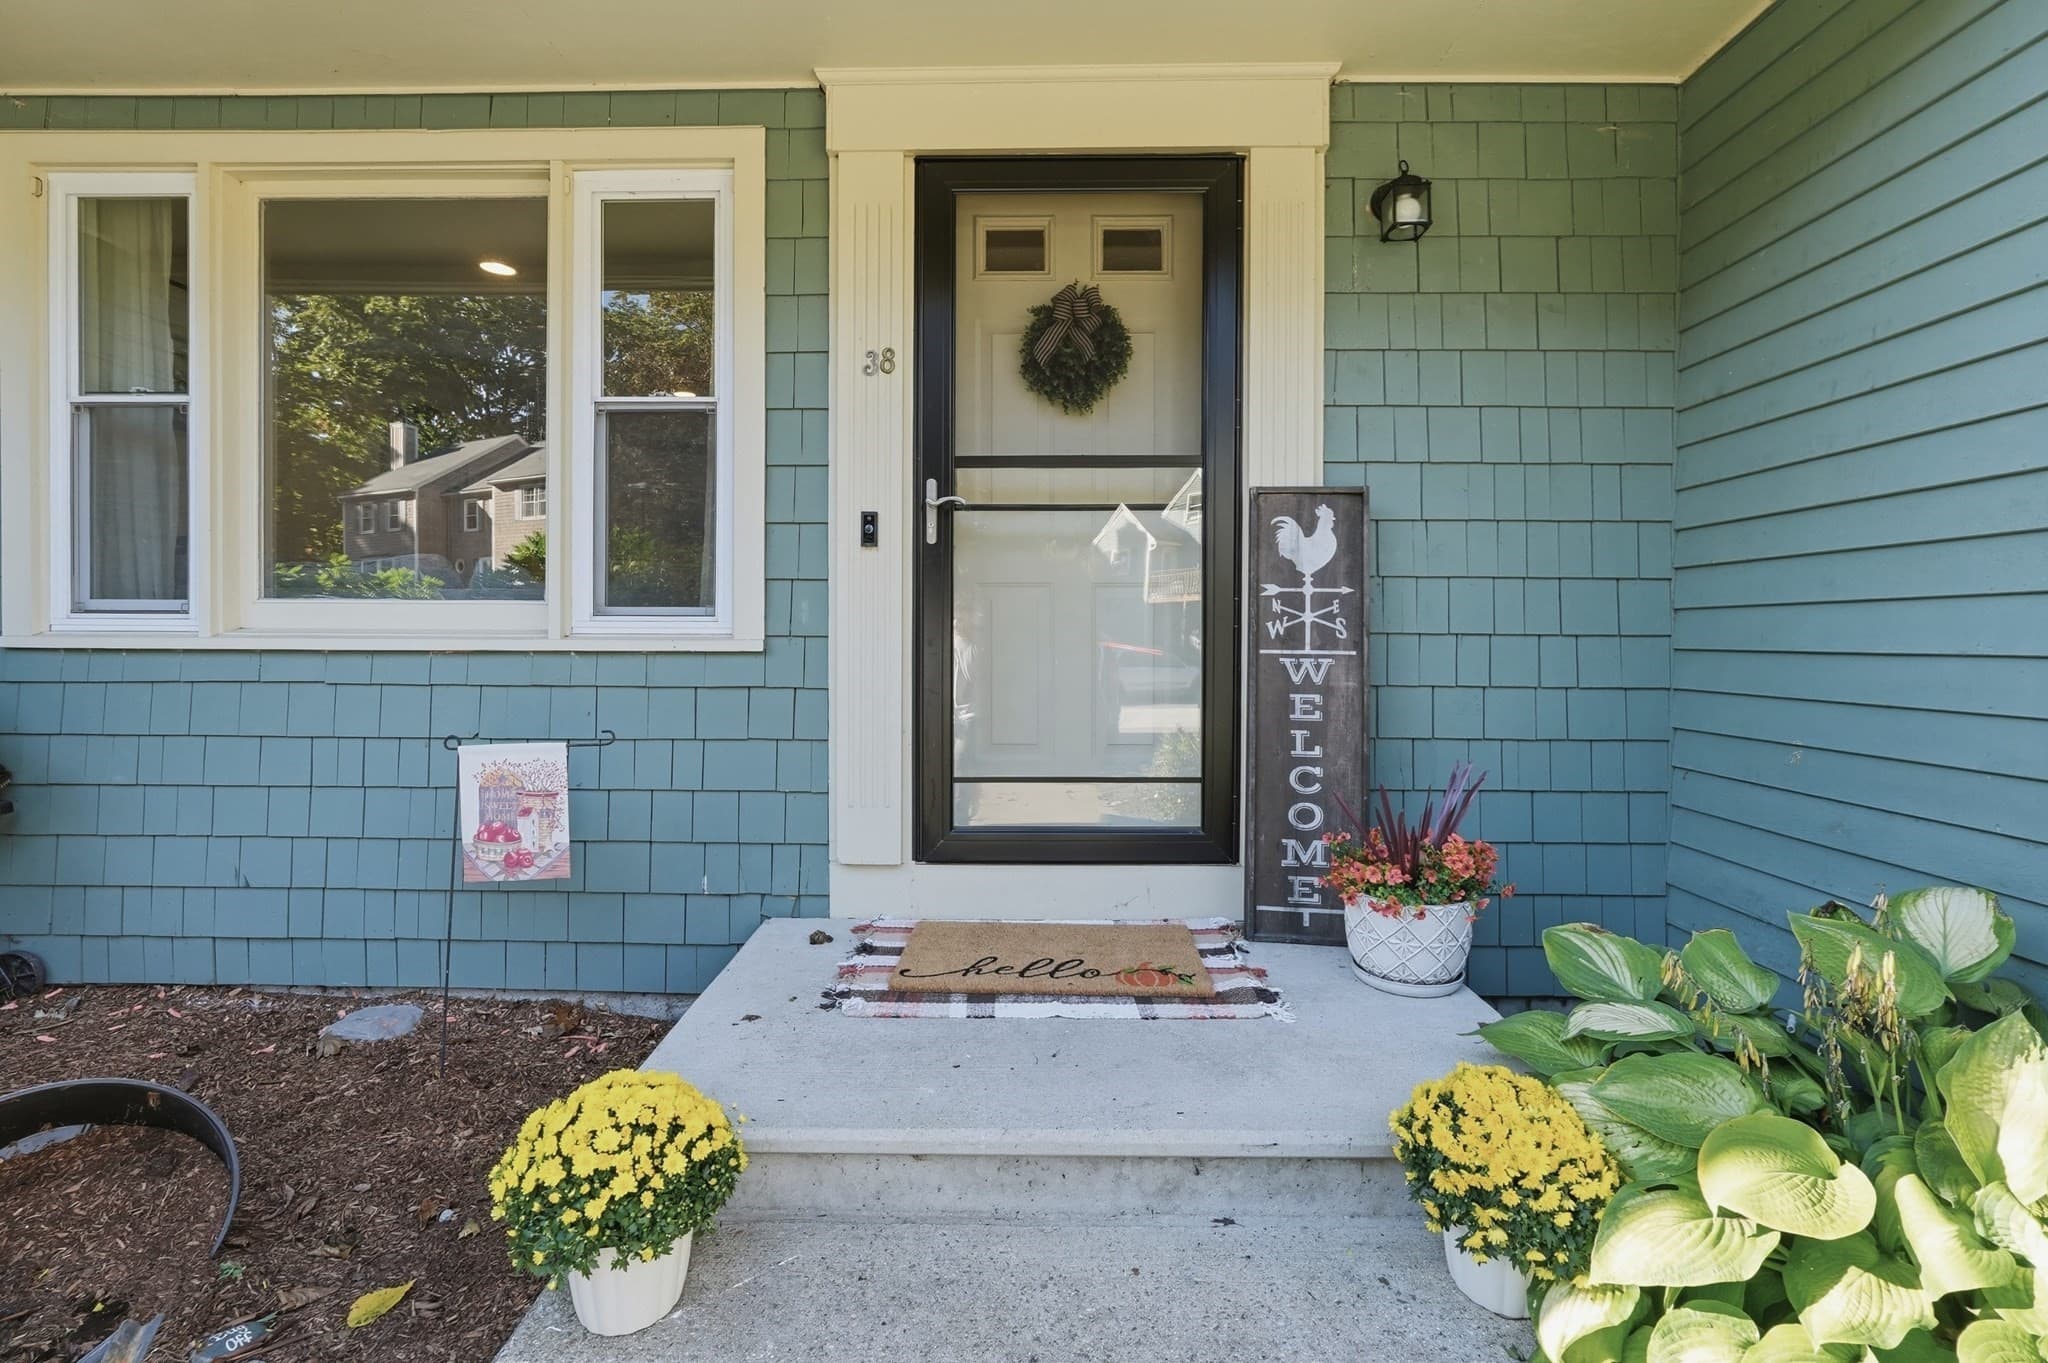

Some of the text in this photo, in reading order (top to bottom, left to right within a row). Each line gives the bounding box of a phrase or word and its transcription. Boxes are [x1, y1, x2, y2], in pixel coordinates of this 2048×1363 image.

[863, 347, 895, 376] 38
[1272, 598, 1281, 614] N
[1333, 599, 1340, 614] E
[1265, 616, 1289, 640] W
[1335, 617, 1347, 639] S
[1279, 657, 1335, 905] WELCOME
[899, 956, 1110, 979] hello
